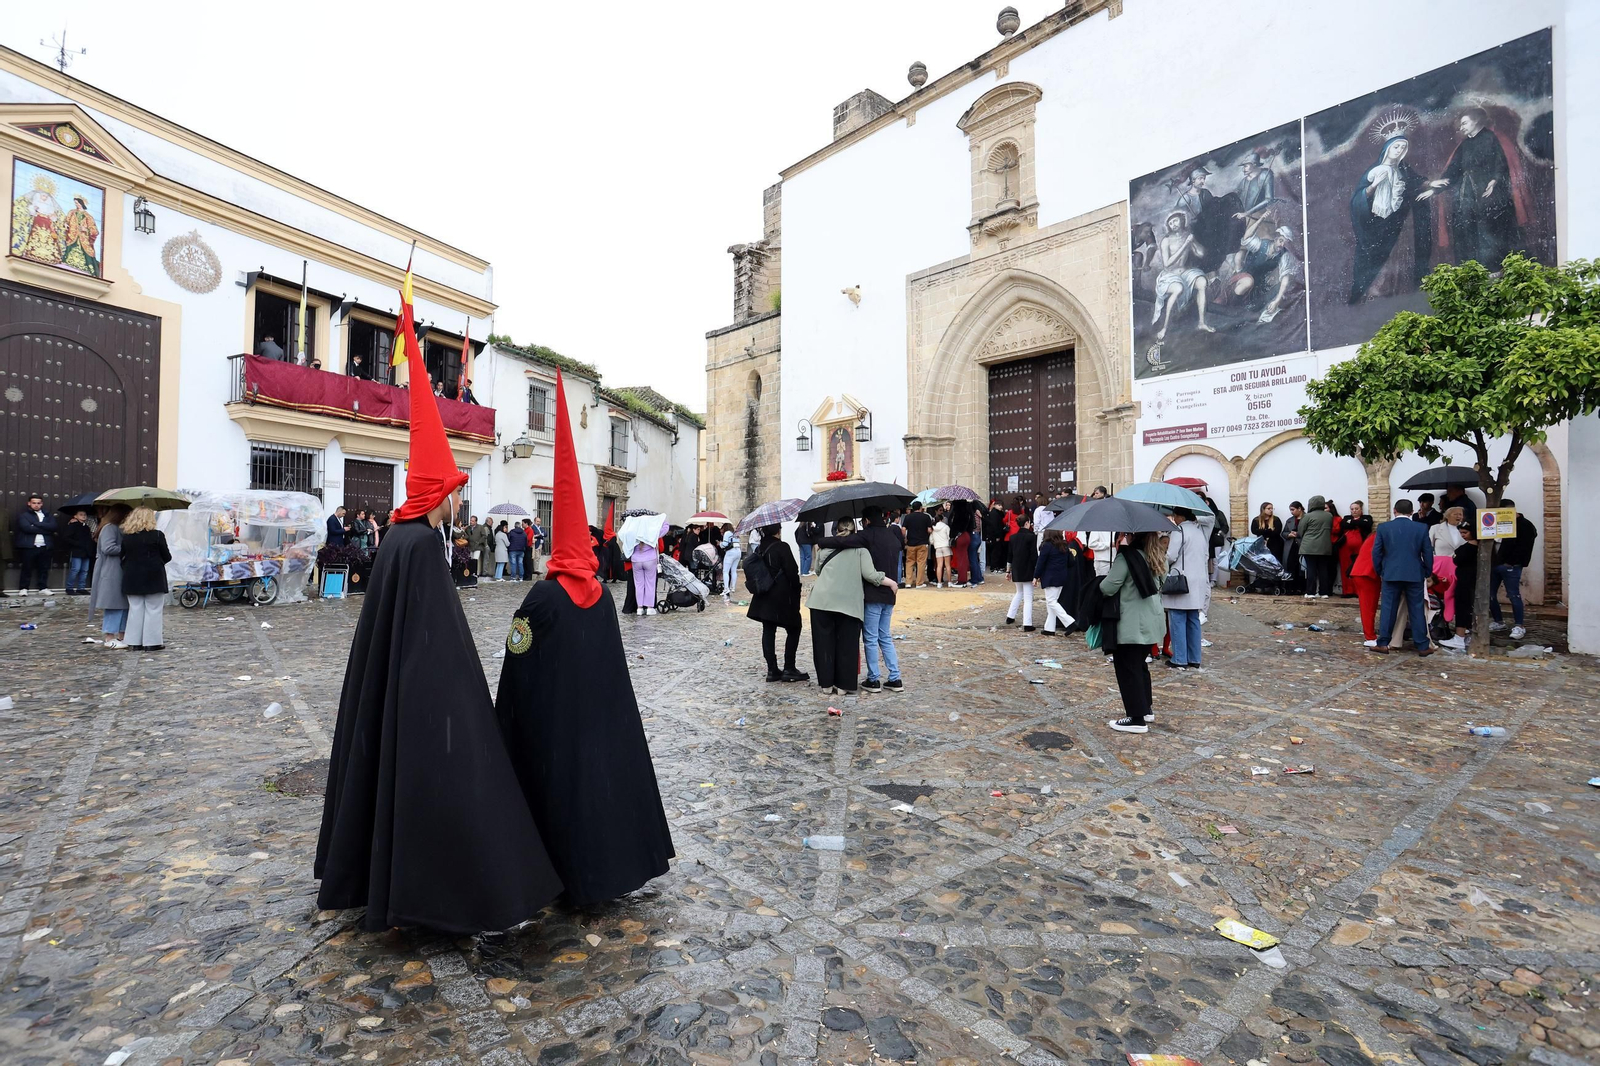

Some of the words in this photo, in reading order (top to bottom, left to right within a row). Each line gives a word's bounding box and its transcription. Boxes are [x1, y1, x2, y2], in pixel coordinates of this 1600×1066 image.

[1230, 372, 1247, 382] CON
[1249, 369, 1259, 380] TU
[1261, 365, 1287, 378] AYUDA
[1213, 386, 1228, 395] ESTA
[1228, 384, 1243, 393] JOYA
[1271, 374, 1307, 387] BRILLANDO
[1247, 399, 1272, 411] 05156
[1210, 426, 1225, 434] ES77
[1226, 424, 1243, 433] 0049
[1244, 422, 1260, 431] 7323
[1261, 420, 1276, 429] 2821
[1277, 418, 1293, 427] 1000
